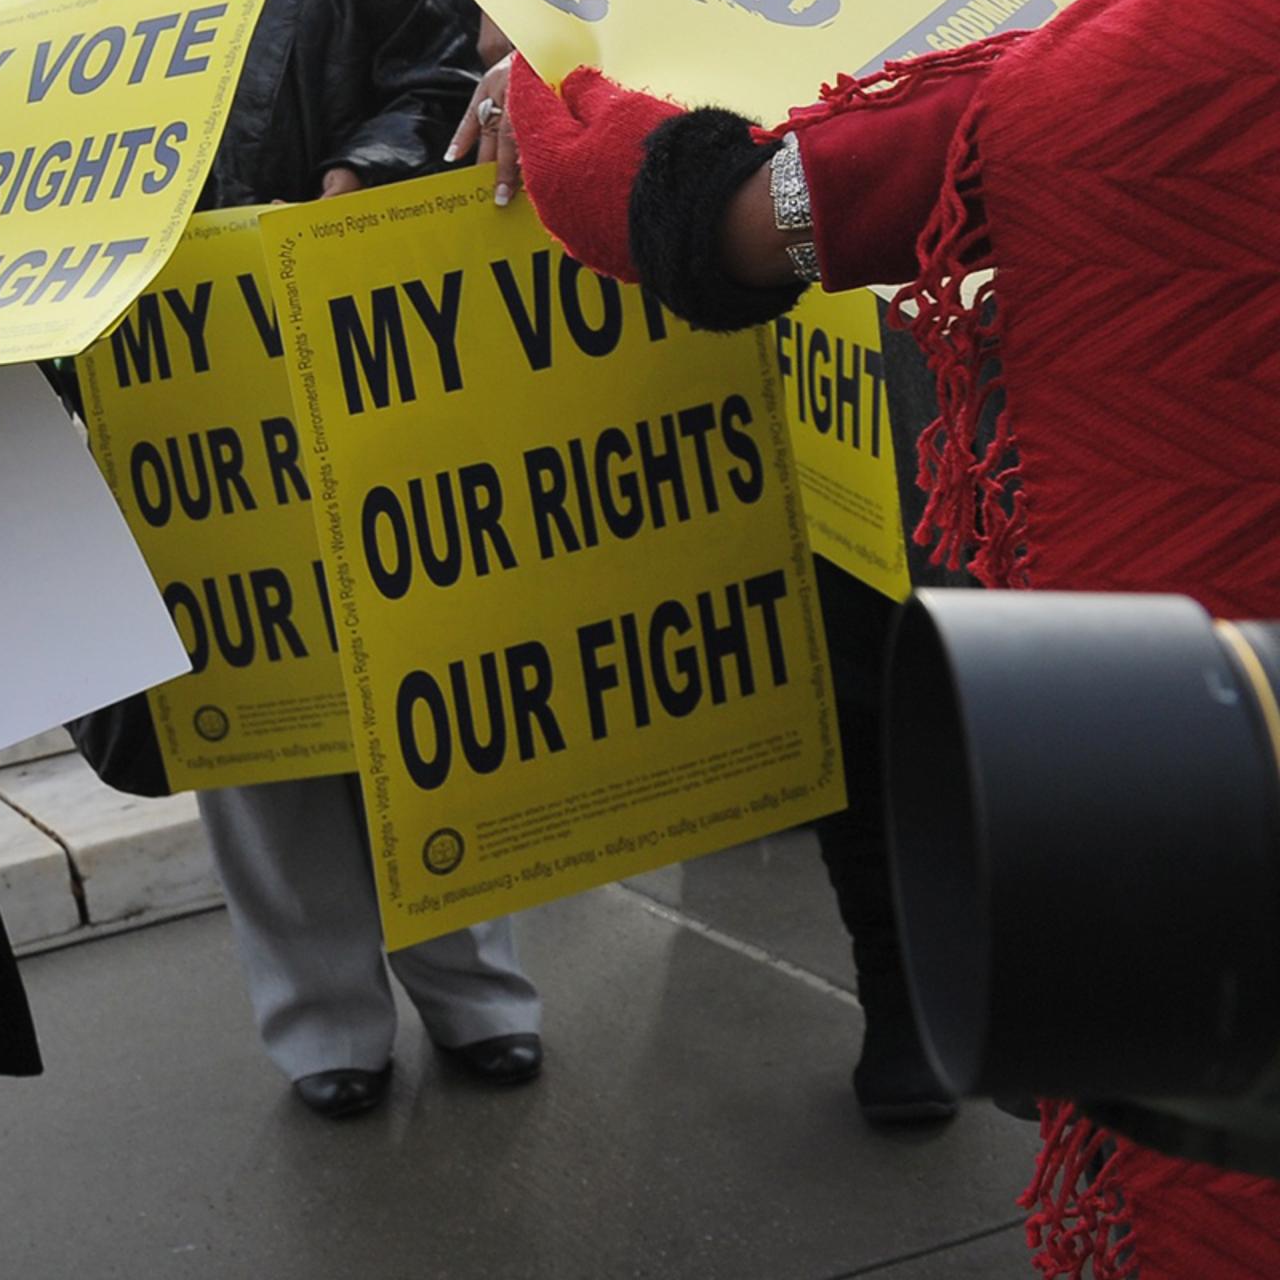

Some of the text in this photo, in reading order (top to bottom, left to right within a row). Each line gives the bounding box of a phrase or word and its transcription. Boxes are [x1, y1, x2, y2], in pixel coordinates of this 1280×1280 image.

[26, 3, 228, 104] VOTE
[309, 221, 345, 239] Voting
[344, 213, 379, 234] Rights
[389, 199, 435, 222] Women's
[434, 193, 468, 214] Rights
[279, 237, 296, 280] Rights
[286, 281, 303, 324] Human
[110, 281, 214, 388] MY
[297, 332, 314, 371] Rights
[328, 270, 464, 416] MY
[490, 250, 680, 371] VO
[775, 314, 885, 459] FIGHT
[305, 372, 329, 455] Environmental
[129, 426, 258, 528] OUR
[323, 463, 339, 502] Rights
[360, 461, 518, 602] OUR
[524, 393, 765, 560] RIGHTS
[329, 501, 345, 554] Worker's
[340, 562, 355, 601] Rights
[163, 567, 309, 674] OUR
[344, 601, 360, 628] Civil
[354, 636, 370, 675] Rights
[359, 675, 377, 730] Women's
[395, 638, 567, 791] OUR
[576, 570, 790, 741] FIGHT
[369, 737, 387, 775] Rights
[374, 775, 391, 814] Voting
[381, 821, 400, 859] Rights
